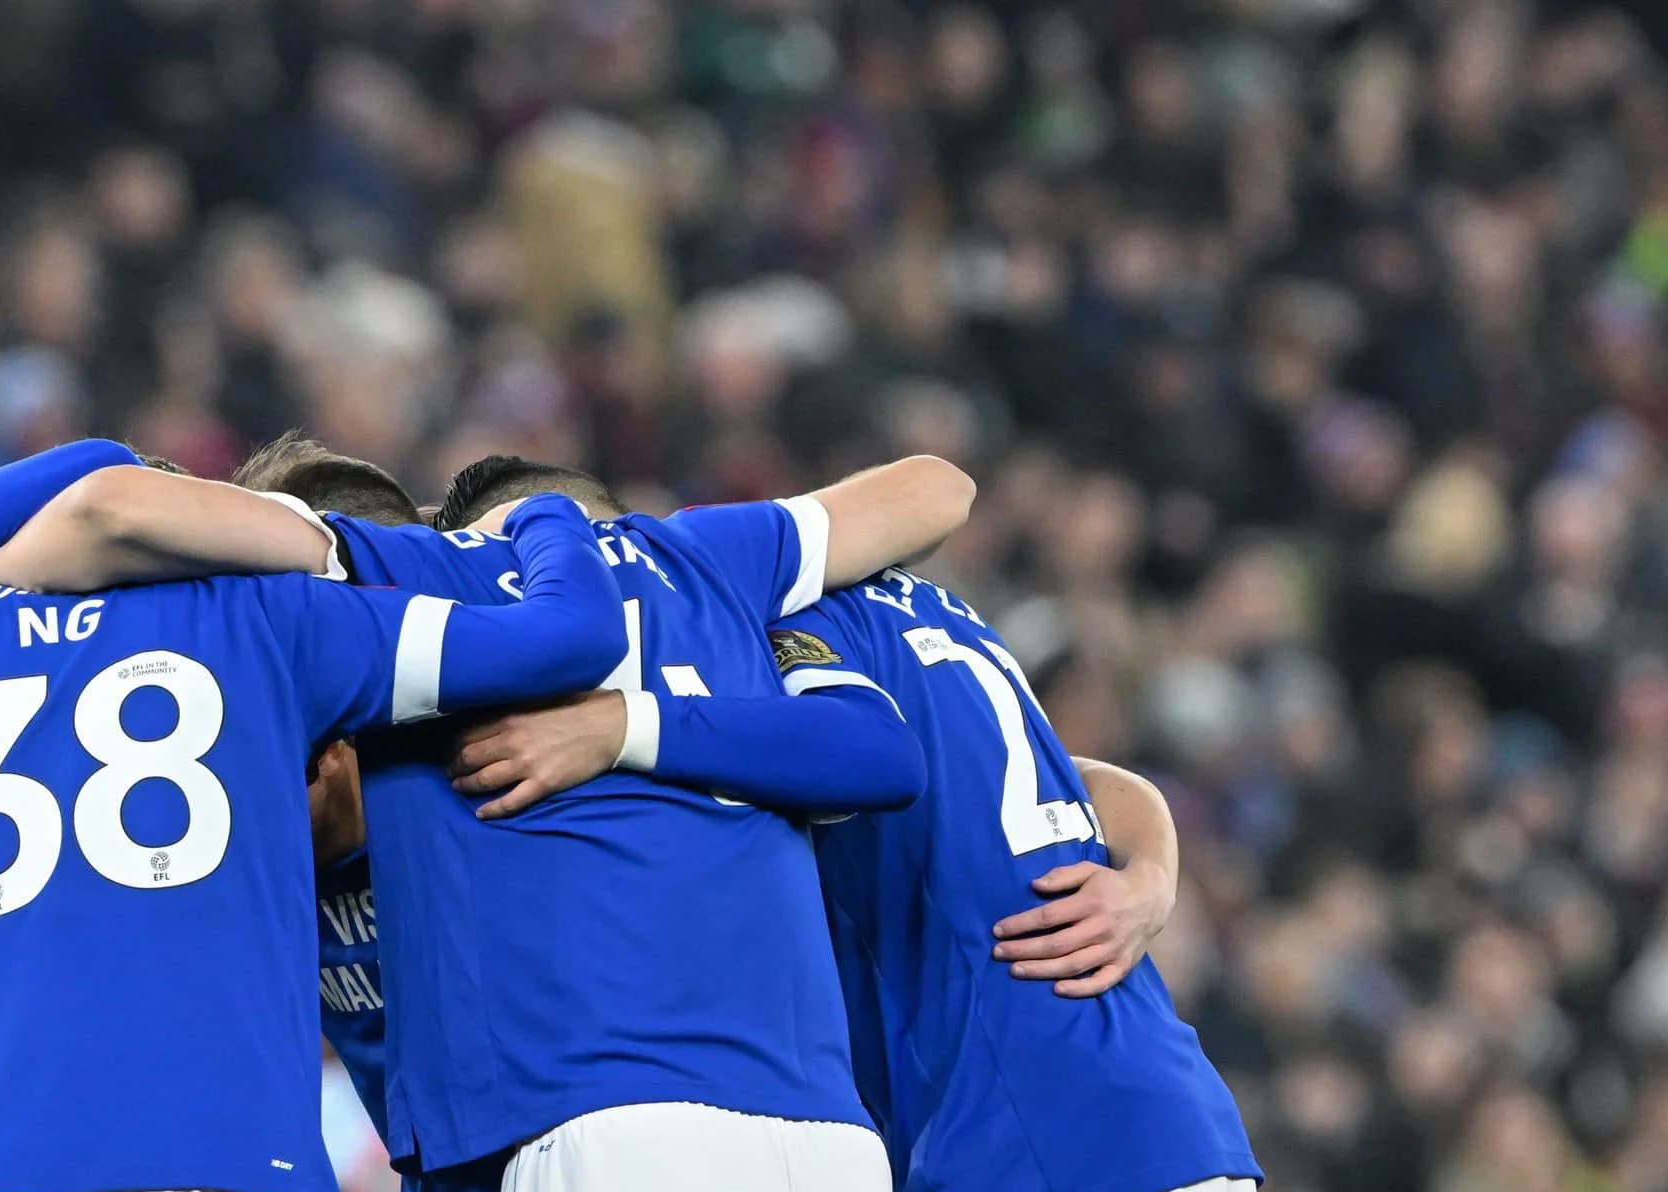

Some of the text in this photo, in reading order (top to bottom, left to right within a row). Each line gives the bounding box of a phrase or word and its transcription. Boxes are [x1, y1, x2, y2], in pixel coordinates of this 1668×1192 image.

[17, 599, 106, 648] NG
[132, 667, 177, 678] COMMUNITY
[154, 872, 170, 881] EFL
